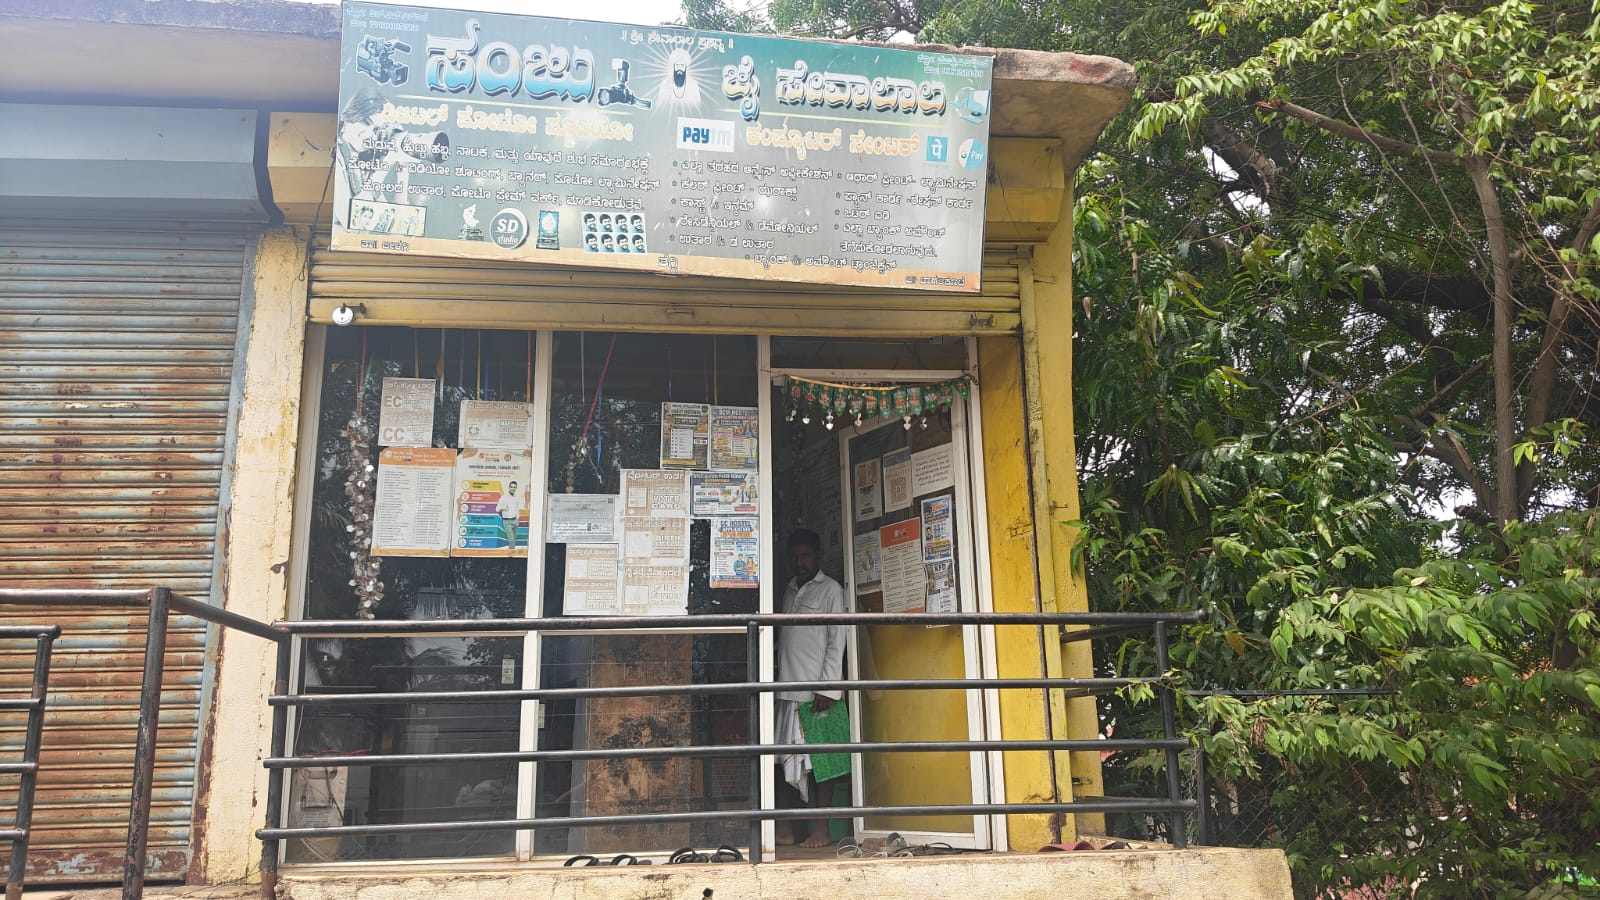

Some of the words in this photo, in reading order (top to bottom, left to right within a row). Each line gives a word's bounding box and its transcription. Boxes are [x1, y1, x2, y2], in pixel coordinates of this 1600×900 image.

[426, 18, 596, 103] ಸಂಜು
[721, 55, 761, 120] ಜೈ
[495, 148, 519, 164] ಮತ್ತು
[566, 152, 588, 166] ಶುಭ
[680, 179, 710, 191] ಕಲರ್
[496, 218, 519, 233] SD
[383, 395, 402, 408] EC
[382, 427, 405, 442] CC
[653, 495, 681, 503] VOTER
